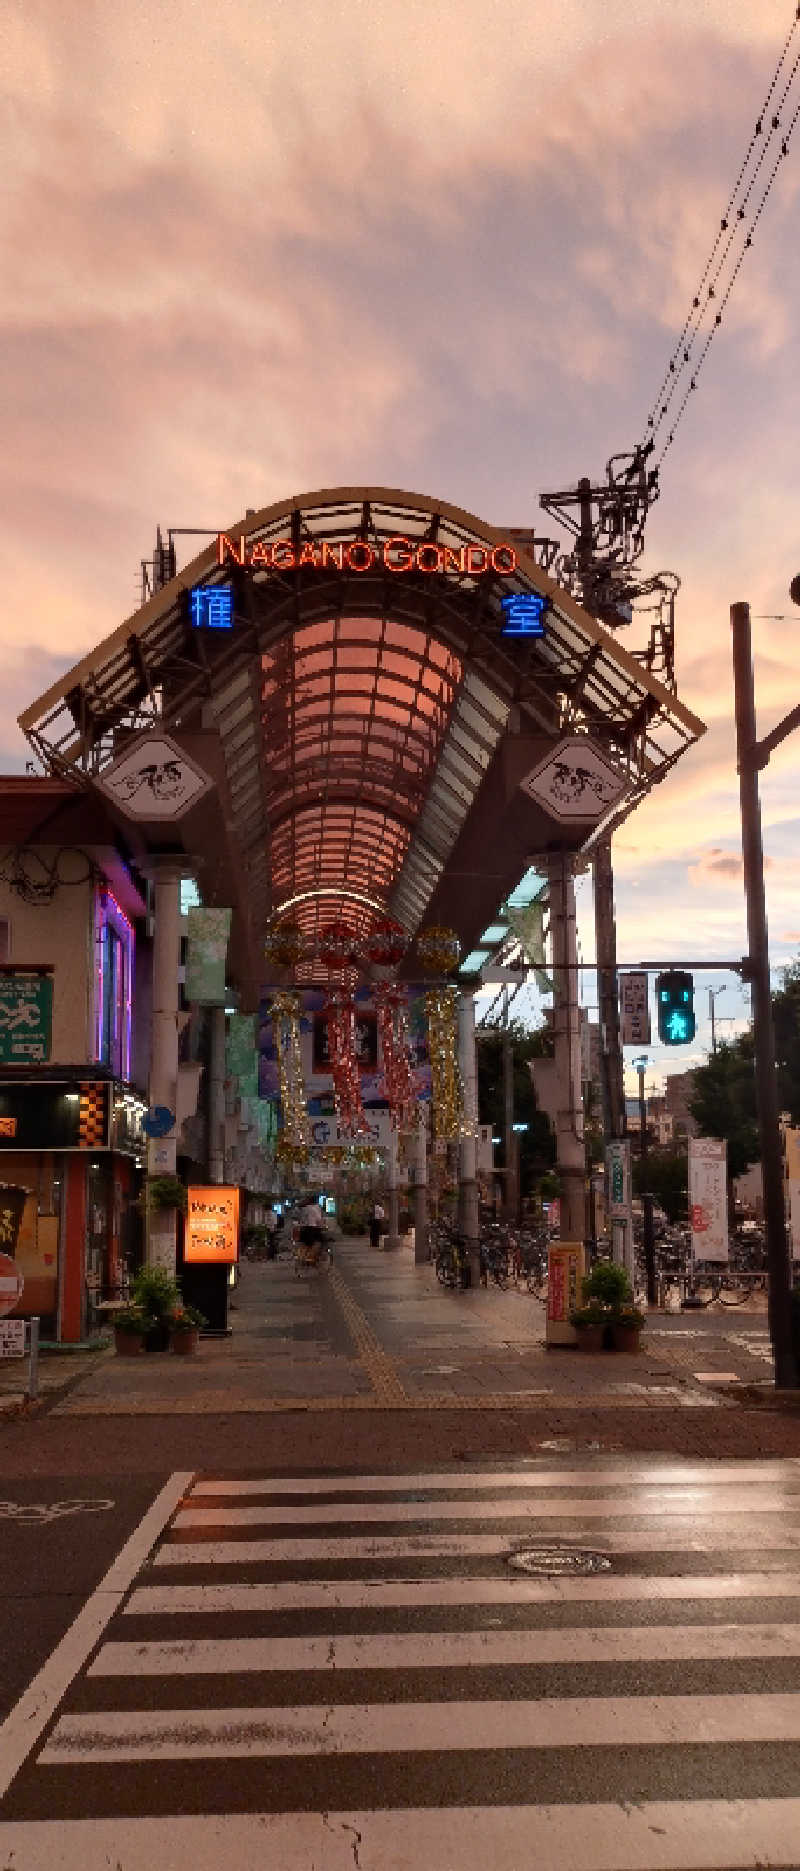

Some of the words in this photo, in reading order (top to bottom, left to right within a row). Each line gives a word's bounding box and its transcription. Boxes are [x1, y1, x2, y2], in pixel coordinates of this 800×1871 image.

[216, 533, 373, 572] NAGANO
[383, 537, 518, 574] GONDO
[501, 594, 546, 635] 堂
